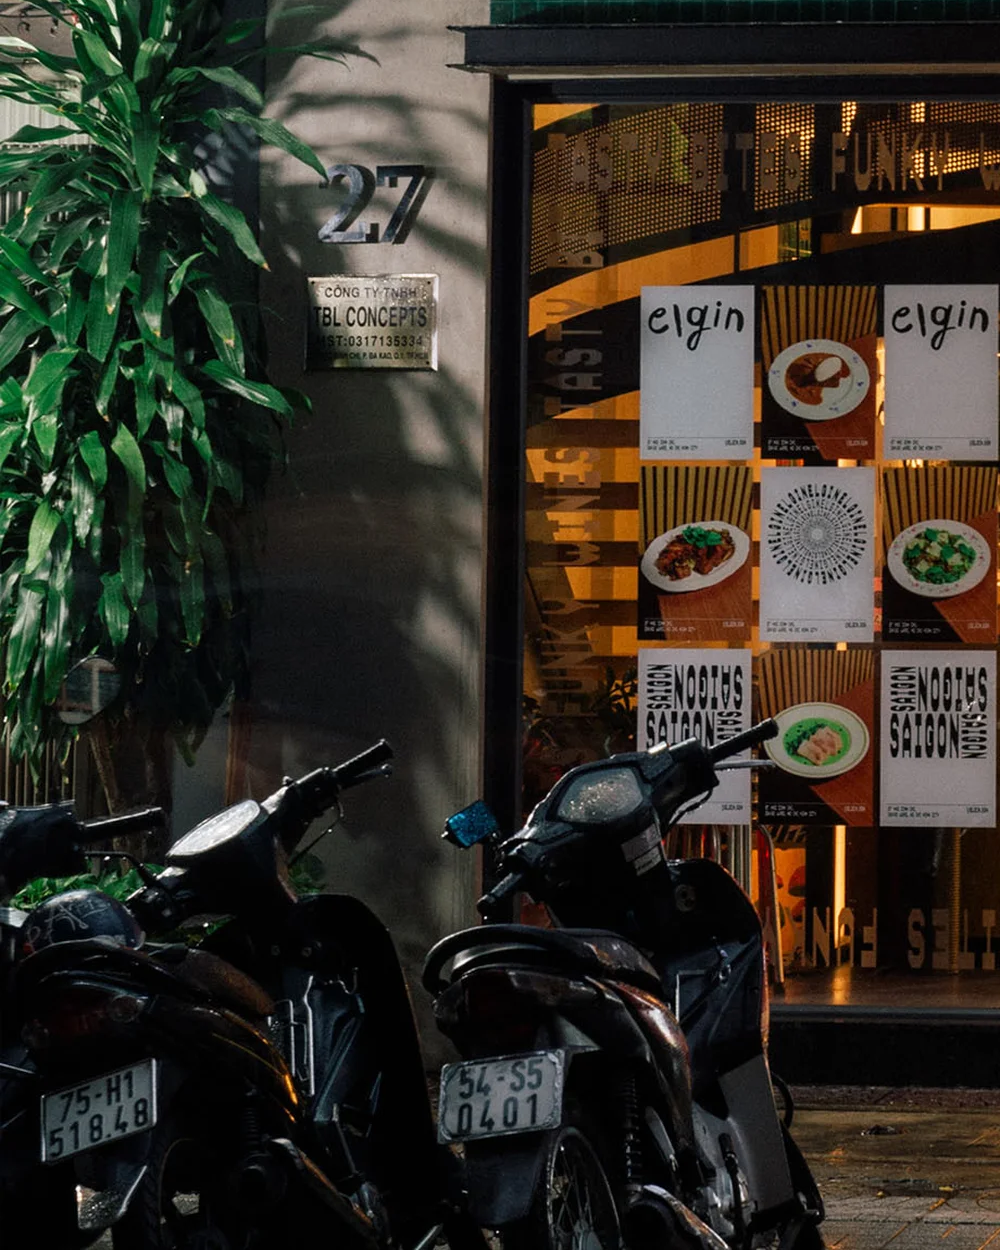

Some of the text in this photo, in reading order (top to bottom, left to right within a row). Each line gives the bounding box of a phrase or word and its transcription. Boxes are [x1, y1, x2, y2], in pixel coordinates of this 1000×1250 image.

[547, 132, 662, 192] TASTY
[691, 132, 801, 192] BITES
[831, 131, 951, 192] FUNKY
[317, 163, 426, 244] 27
[364, 286, 379, 298] TY
[384, 286, 418, 298] TNHH
[313, 305, 427, 328] TBL CONCEPTS
[648, 300, 746, 352] elgin
[891, 299, 990, 351] elgin
[543, 297, 604, 416] TASTY
[542, 446, 602, 566] WINES
[646, 664, 673, 710] SAIGON
[674, 664, 744, 711] SAIGON
[890, 666, 917, 712] SAIGON
[918, 666, 988, 712] SAIGON
[889, 713, 960, 759] SAIGON
[961, 713, 988, 759] SAIGON
[60, 1070, 134, 1124] 75-H1
[459, 1058, 543, 1099] 54-S5
[49, 1097, 149, 1158] 518.48
[457, 1093, 538, 1135] 0401
